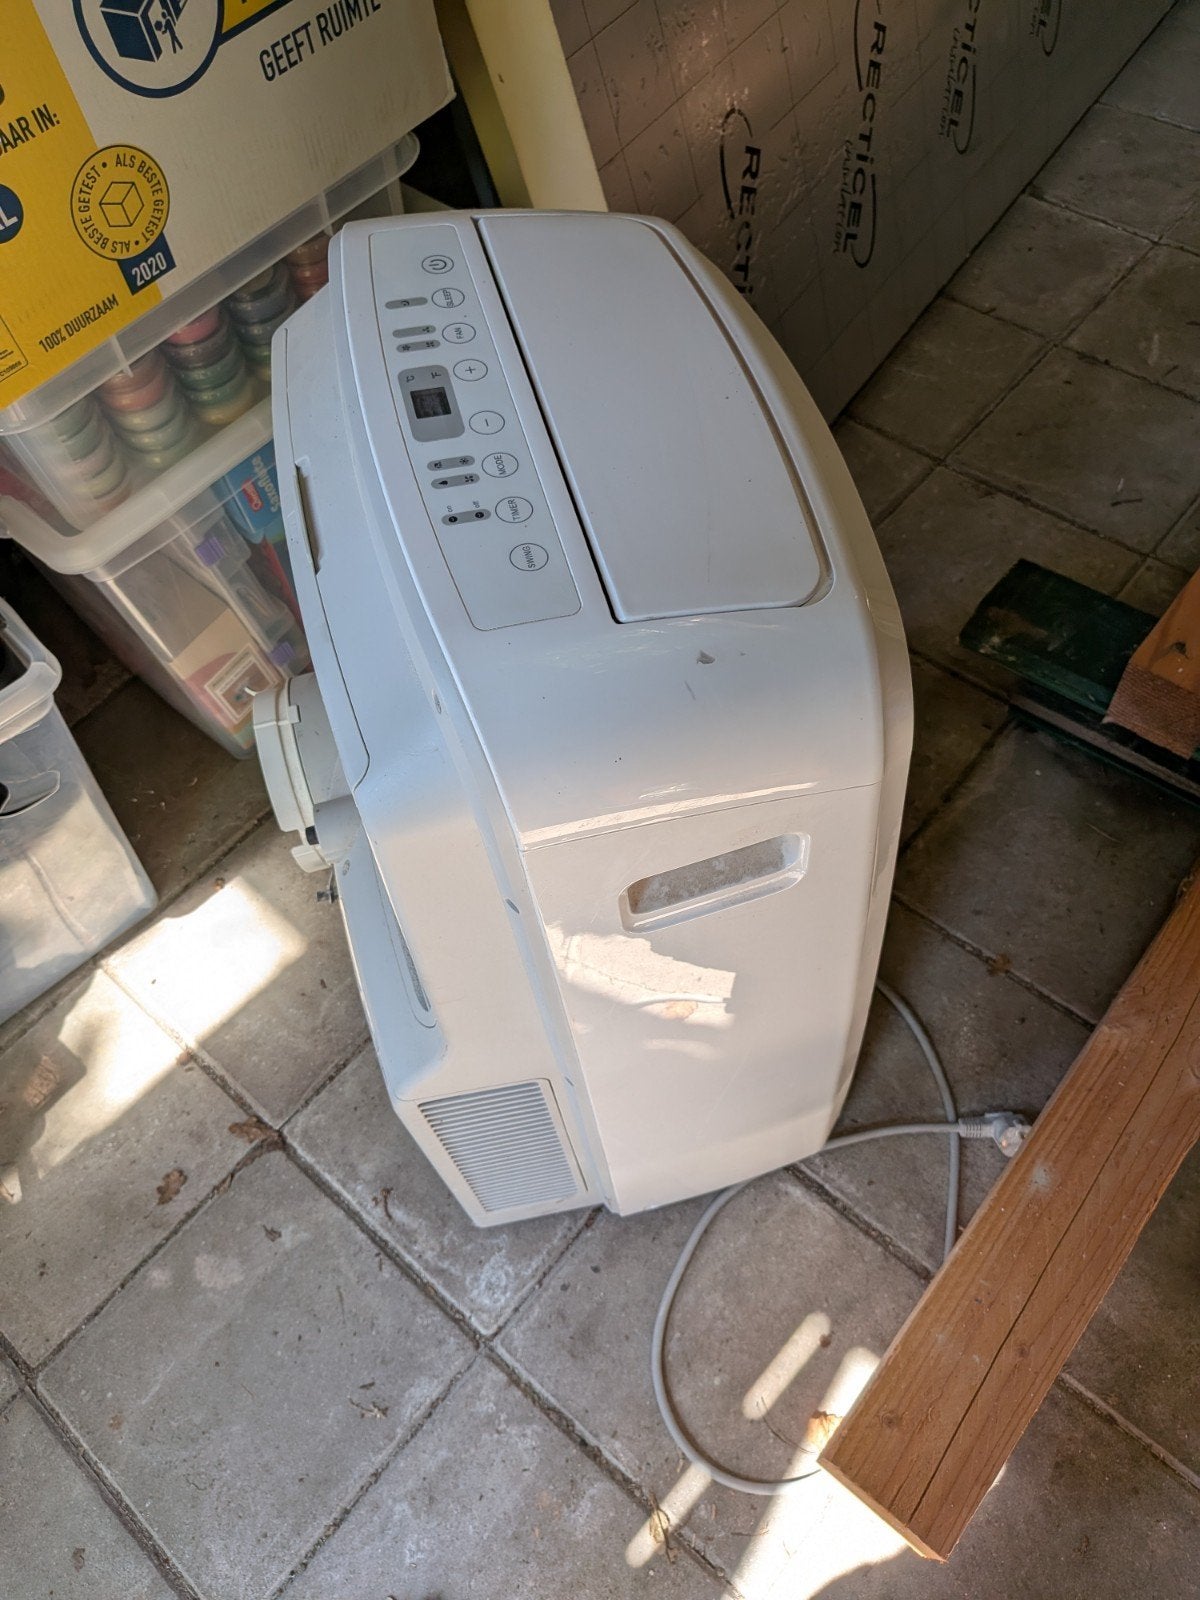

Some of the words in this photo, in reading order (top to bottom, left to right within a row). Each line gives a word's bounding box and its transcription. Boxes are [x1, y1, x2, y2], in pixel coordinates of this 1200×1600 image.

[259, 21, 316, 82] GEEFT
[0, 116, 36, 156] AAR
[31, 103, 60, 134] IN:
[115, 153, 136, 169] ALS
[137, 160, 164, 197] BESTE
[78, 165, 101, 213] GETEST
[81, 215, 110, 250] BESTE
[140, 199, 164, 243] GETEST
[110, 240, 131, 254] ALS
[131, 252, 168, 287] 2020
[442, 289, 455, 308] SLEEP
[38, 327, 67, 353] 100%
[64, 293, 120, 337] DUURZAAM
[454, 327, 464, 340] FAN
[493, 455, 507, 475] MODE
[507, 499, 520, 521] TIMER
[522, 545, 536, 569] SWING
